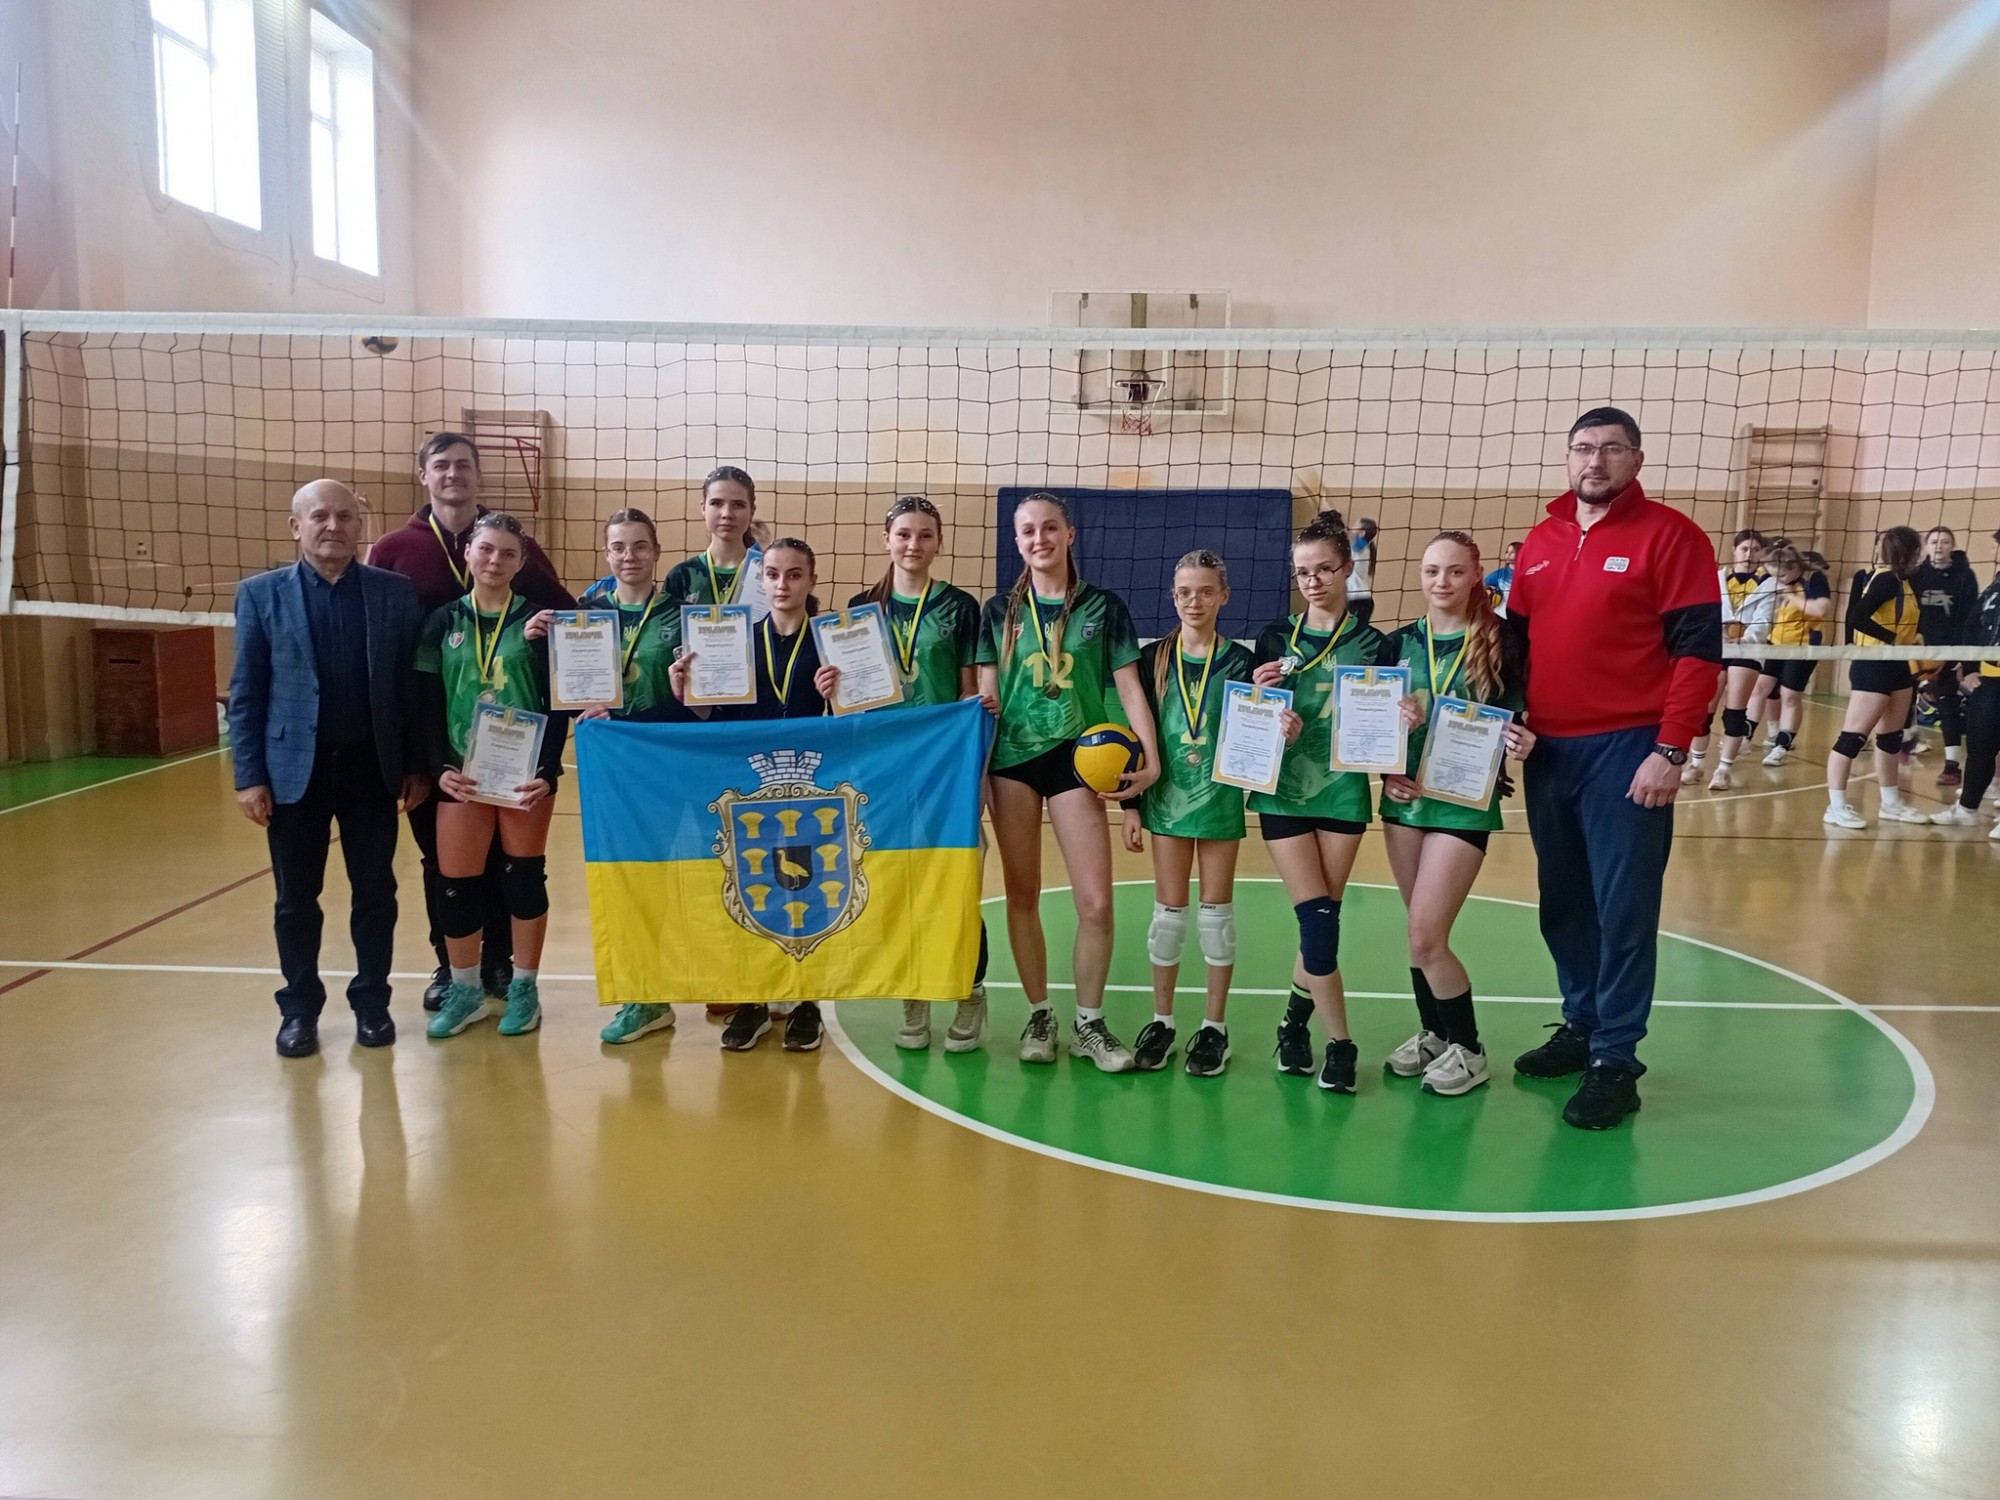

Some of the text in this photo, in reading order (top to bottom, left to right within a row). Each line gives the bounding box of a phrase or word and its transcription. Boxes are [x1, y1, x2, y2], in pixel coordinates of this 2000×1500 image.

[480, 655, 509, 690] 4
[1023, 651, 1075, 689] 12
[1180, 710, 1208, 745] 2
